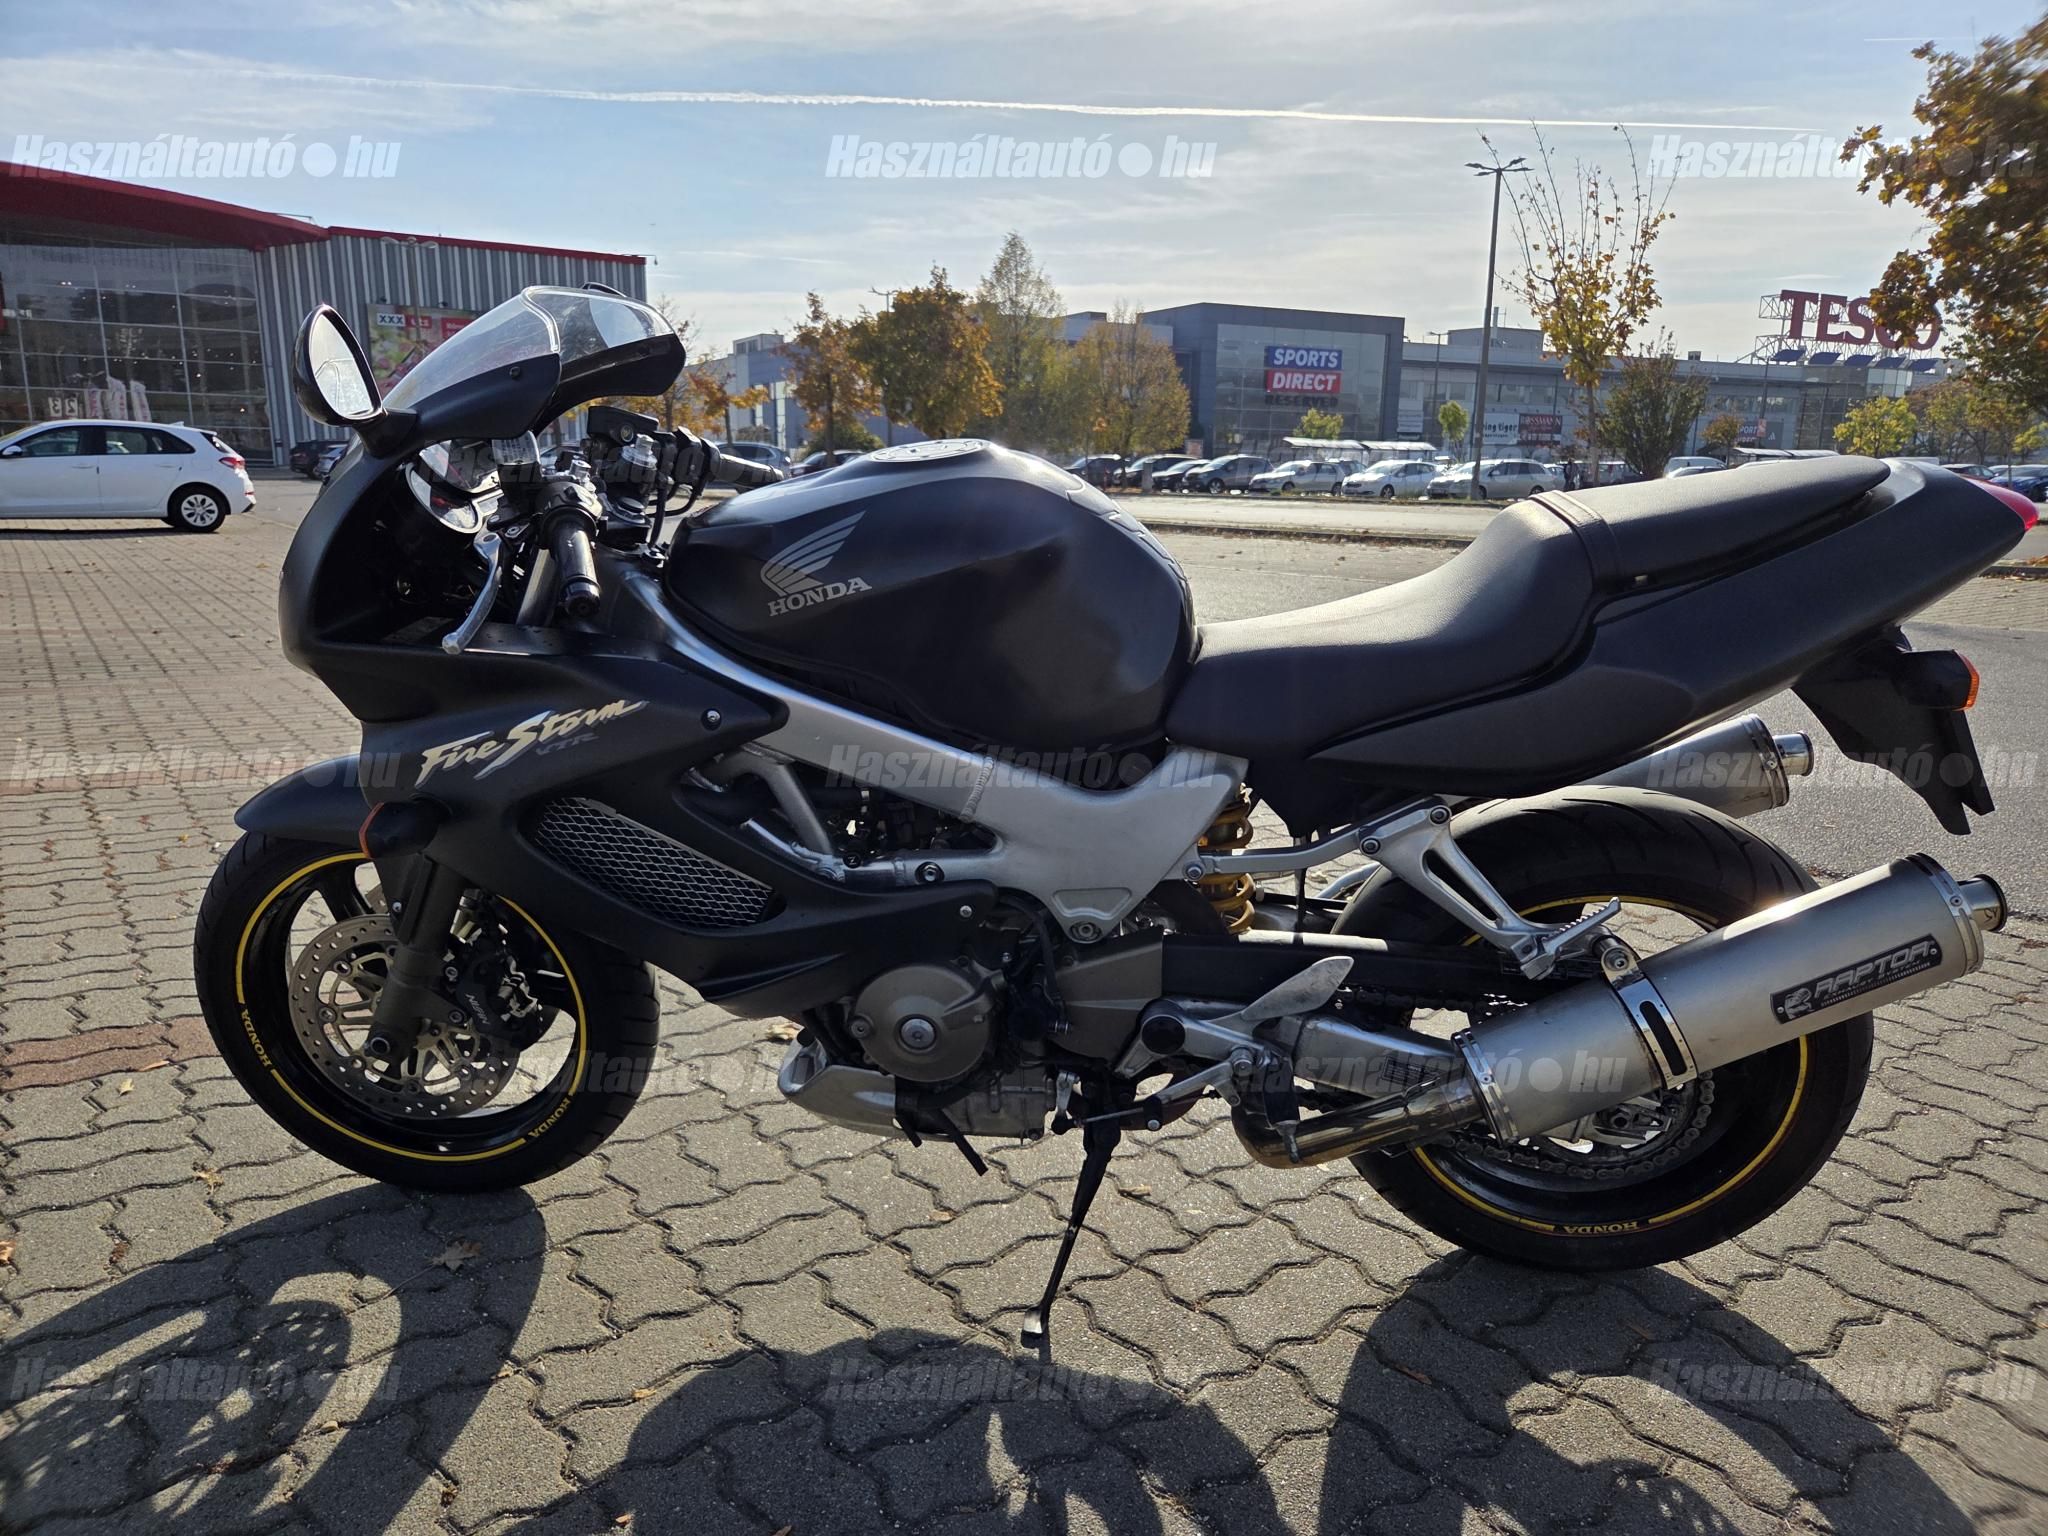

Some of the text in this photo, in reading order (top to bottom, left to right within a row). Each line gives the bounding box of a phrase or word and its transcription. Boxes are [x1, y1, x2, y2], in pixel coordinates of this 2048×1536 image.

[1273, 348, 1339, 368] SPORTS
[1272, 372, 1337, 391] DIRECT
[1498, 422, 1518, 432] tiger
[768, 577, 872, 616] HONDA
[1814, 941, 1930, 998] RAPTOR
[241, 1009, 272, 1066] HONDA
[528, 1098, 570, 1137] HONDA
[1563, 1221, 1638, 1235] HONDA
